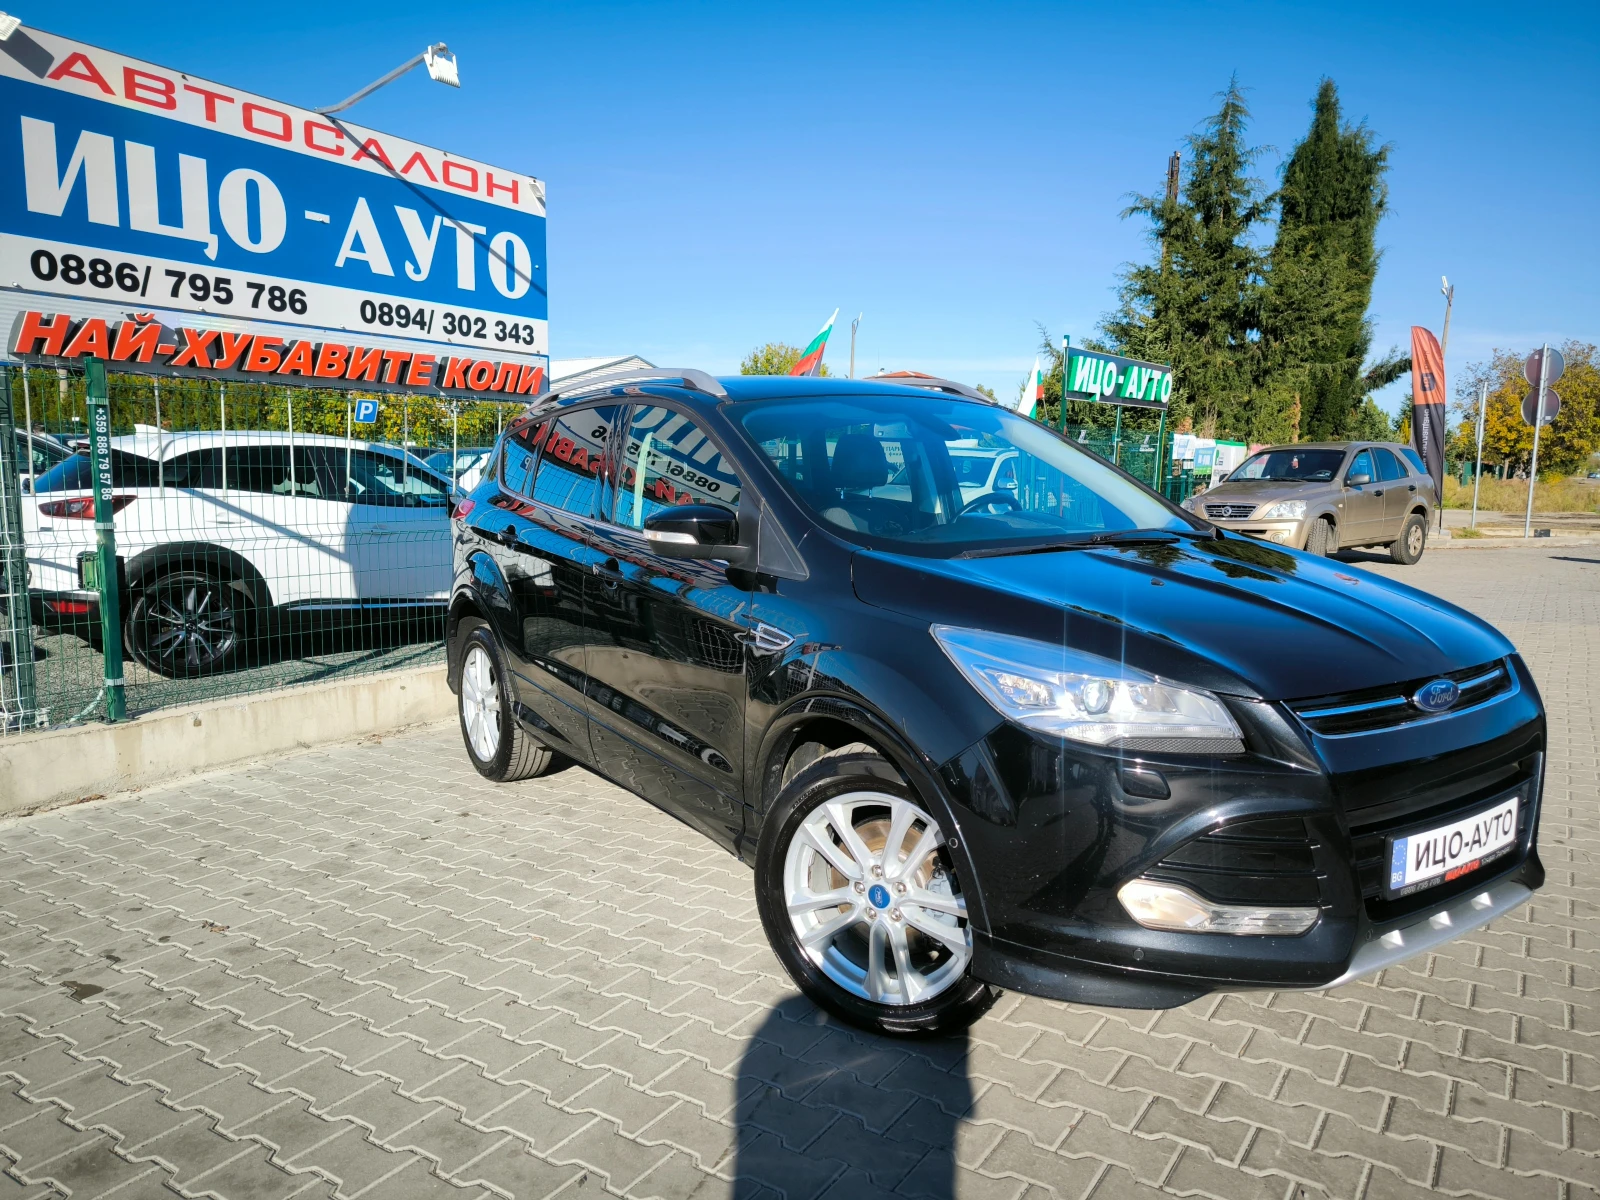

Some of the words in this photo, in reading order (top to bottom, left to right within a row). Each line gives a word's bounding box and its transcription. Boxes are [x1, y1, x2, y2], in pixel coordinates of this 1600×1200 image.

[47, 52, 519, 204] АВТОСАЛОН
[30, 249, 151, 297] 0886/
[164, 269, 234, 305] 795
[246, 282, 308, 315] 786
[360, 299, 434, 334] 0894/
[442, 312, 487, 339] 302
[494, 320, 534, 346] 343
[12, 310, 436, 386] НАЙ-ХУБАВИТЕ
[442, 356, 544, 396] КОЛИ
[1073, 355, 1173, 403] ИЦО-АУТО
[96, 407, 107, 433] +359
[359, 402, 374, 420] P
[97, 436, 108, 455] 886
[99, 457, 109, 470] 79
[100, 473, 111, 485] 57
[101, 488, 112, 500] 86
[1429, 684, 1455, 705] Ford
[1415, 808, 1513, 871] ИЦО-АУТО
[1391, 871, 1403, 883] BG
